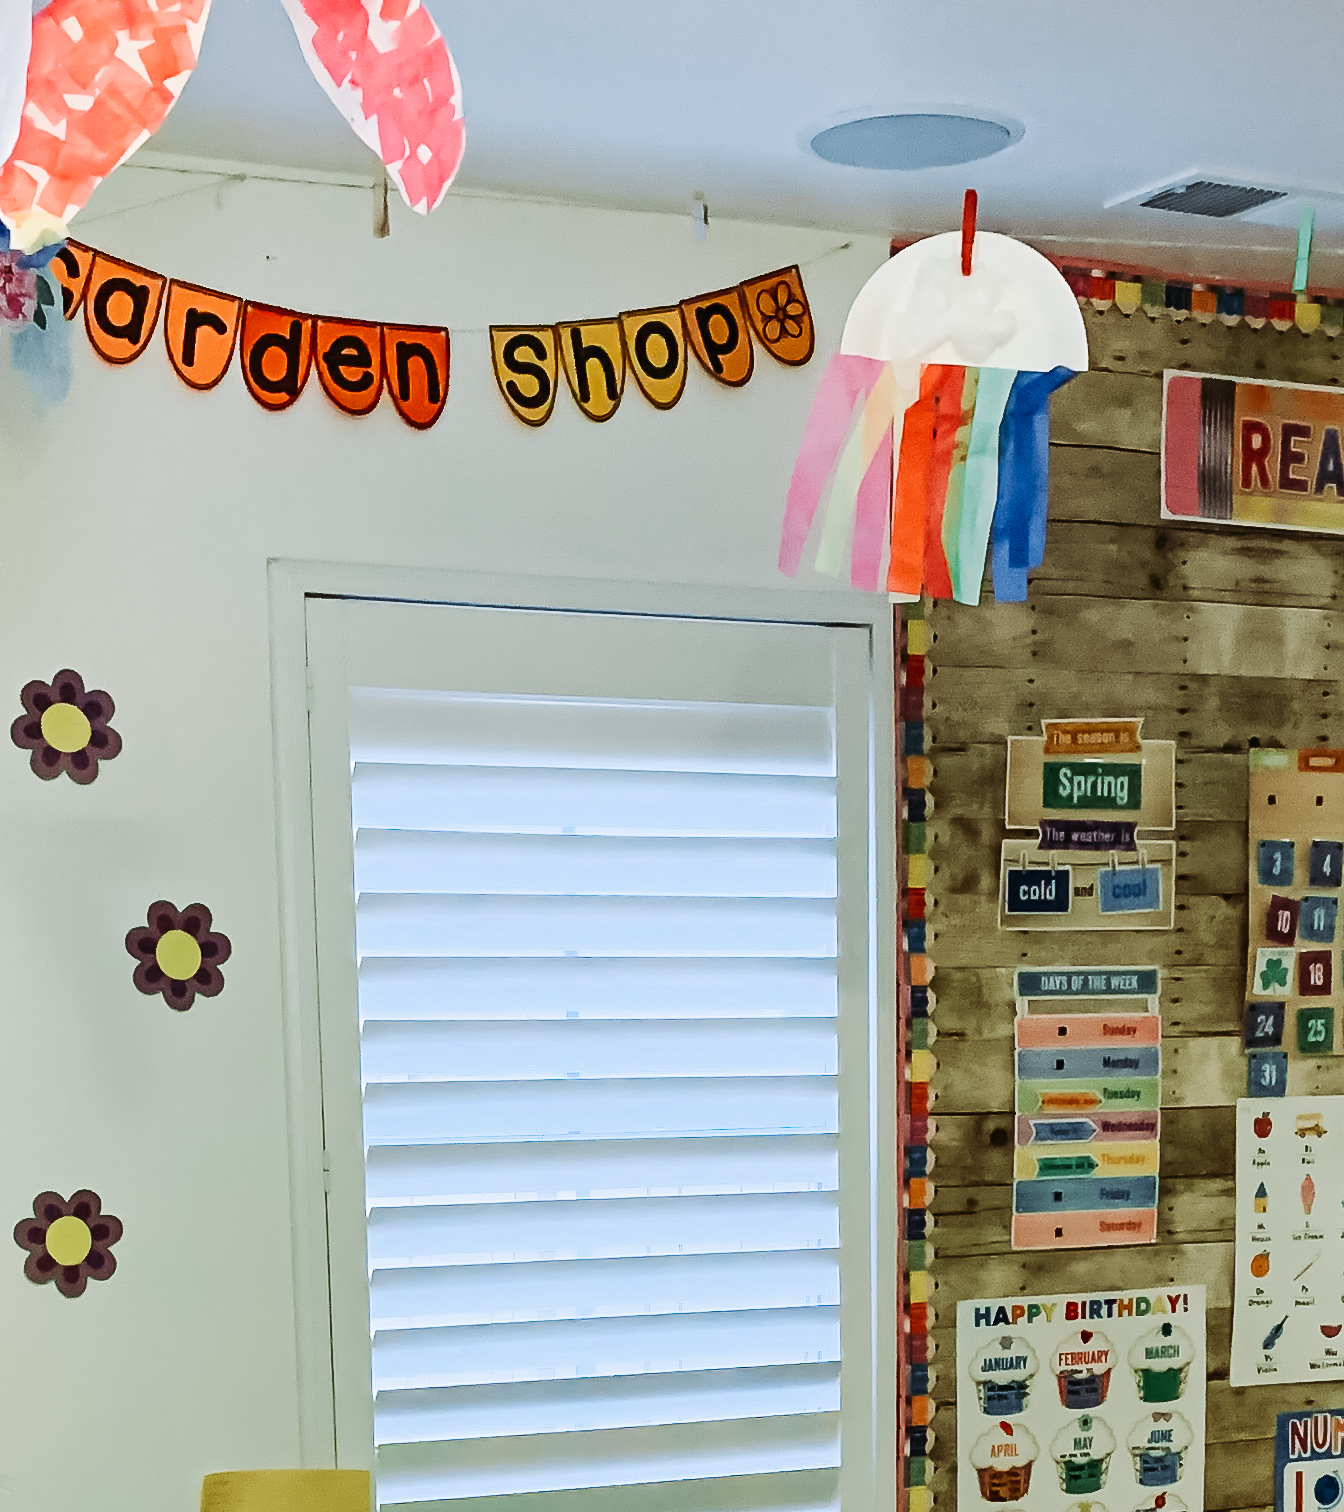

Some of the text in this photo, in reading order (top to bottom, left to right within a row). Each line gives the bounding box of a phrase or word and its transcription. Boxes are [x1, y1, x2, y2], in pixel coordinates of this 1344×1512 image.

[1058, 767, 1129, 805] Spring
[1019, 879, 1147, 900] cold and cool
[1277, 909, 1291, 934] 10
[1313, 908, 1326, 932] 11
[1041, 974, 1138, 992] DAYS OF THE WEEK
[1102, 1023, 1137, 1038] Sunday
[1255, 1014, 1274, 1037] 24
[1307, 1018, 1326, 1042] 25
[1260, 1063, 1276, 1087] 31
[974, 1293, 1189, 1328] HAPPY BIRTHDAY!
[981, 1344, 1180, 1373] JANUARY FEBRUARY MARCH
[990, 1428, 1174, 1458] APRIL MAY JUNE
